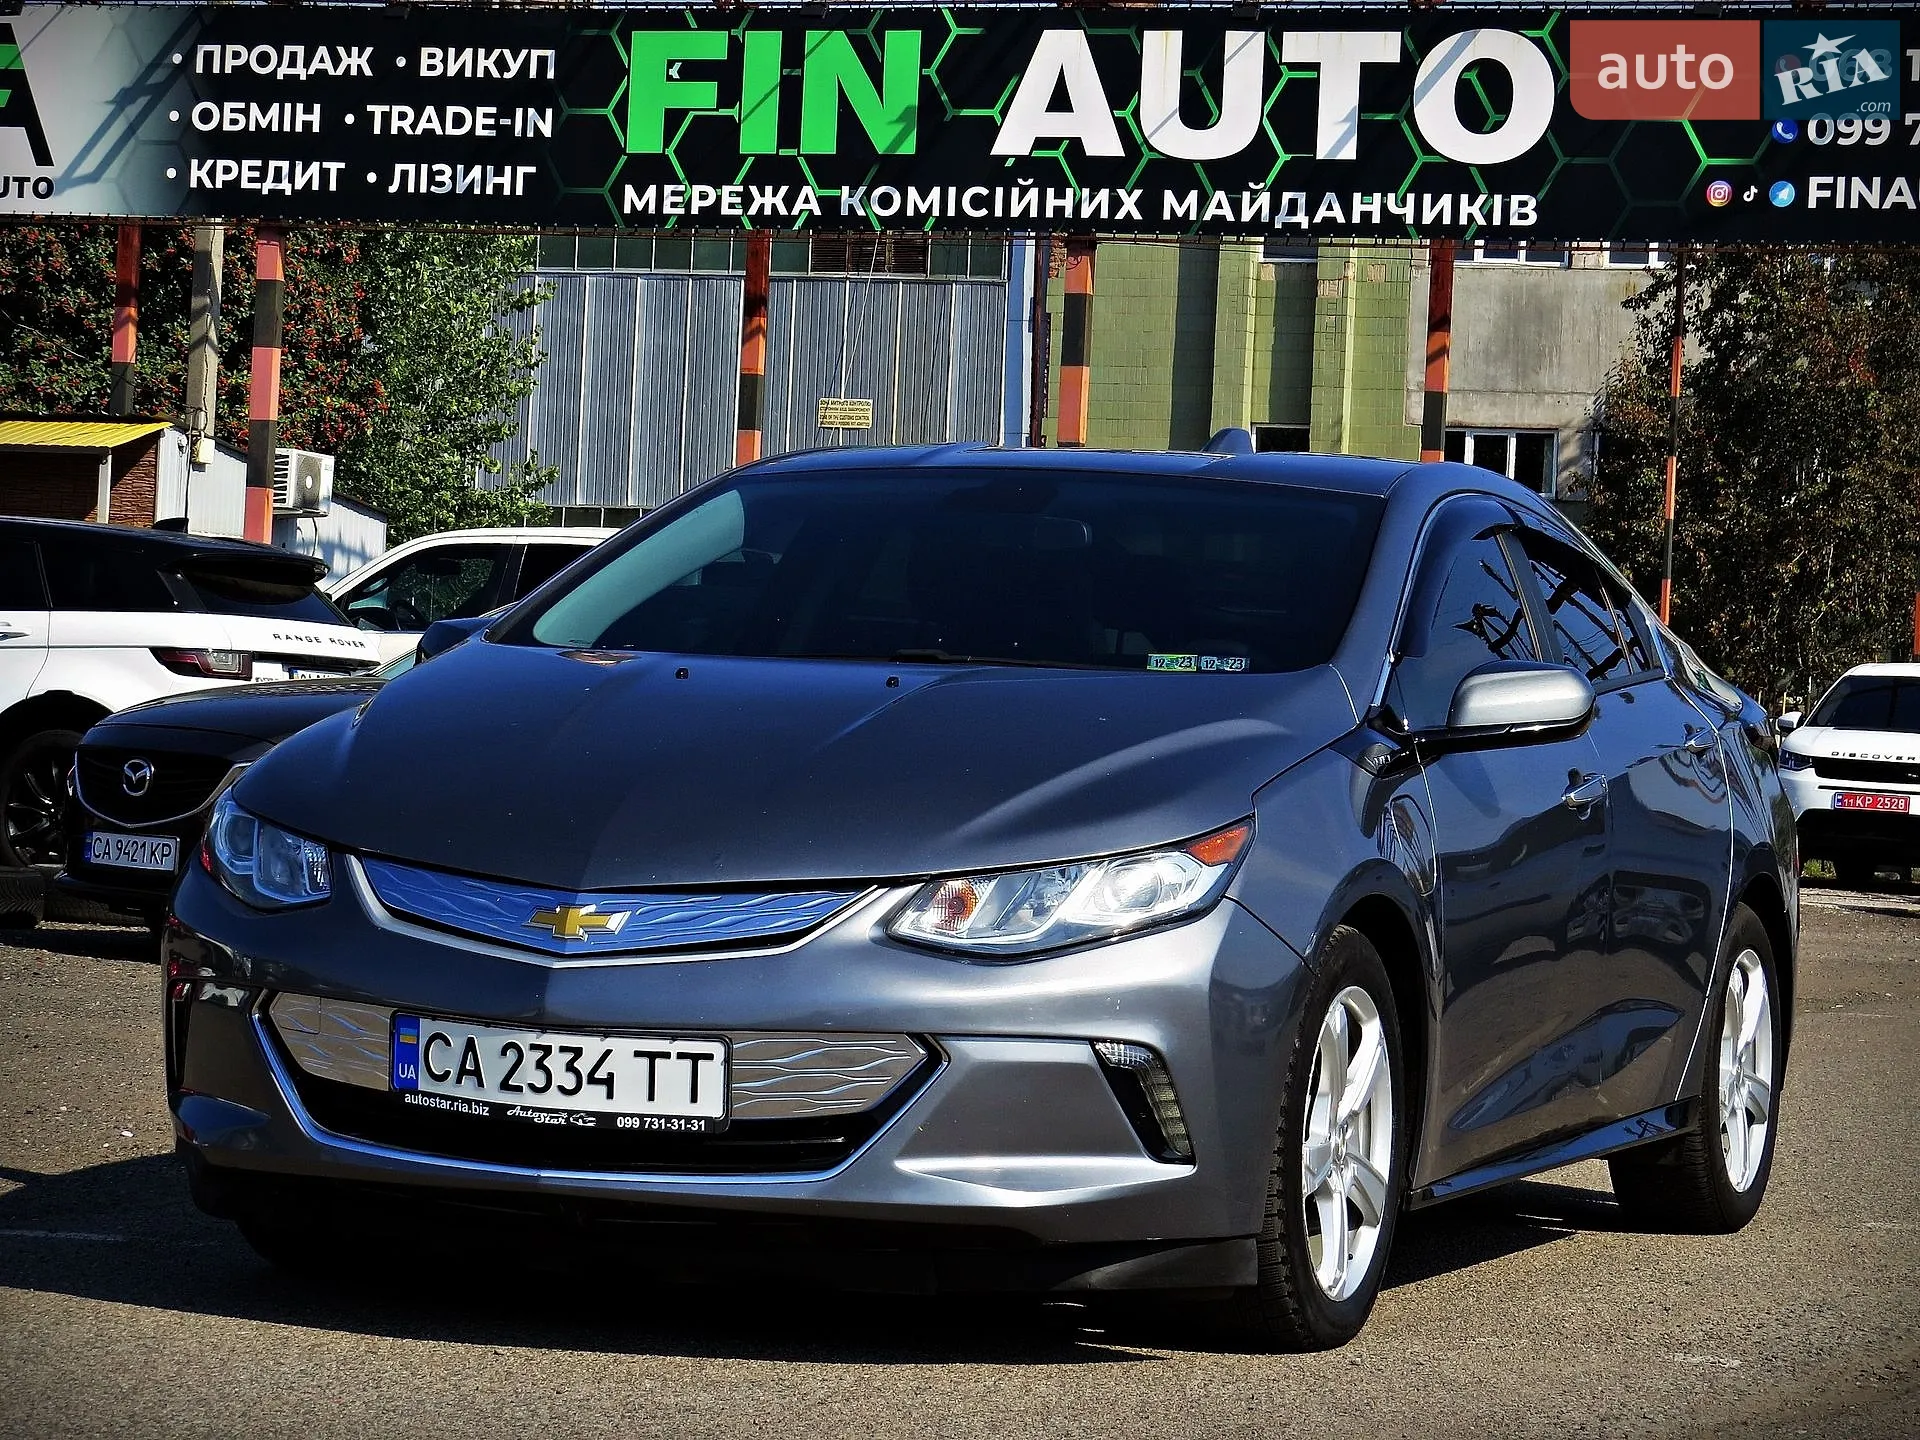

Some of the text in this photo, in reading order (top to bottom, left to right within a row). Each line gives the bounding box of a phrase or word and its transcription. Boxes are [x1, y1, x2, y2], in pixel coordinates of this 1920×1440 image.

[195, 44, 556, 81] ПРОДАЖ ВИКУП
[626, 28, 1555, 165] FIN AUTO
[191, 102, 322, 133] ОБМІН
[367, 104, 554, 138] TRADE-IN
[1807, 112, 1891, 146] 099
[189, 159, 537, 196] КРЕДИТ ЛІЗИНГ
[1807, 176, 1920, 210] FINA
[623, 178, 1538, 230] МЕРЕЖА КОМІСІЙНИХ МАЙДАНЧИКІВ
[272, 633, 366, 648] RANGE ROVER
[1831, 752, 1920, 760] DISCOVER
[1876, 798, 1905, 810] 2528
[92, 837, 172, 866] CA 9421 KP
[399, 1062, 416, 1080] UA
[423, 1032, 714, 1104] CA 2334 TT
[404, 1093, 490, 1116] autostar.ria.biz
[617, 1116, 706, 1131] 099 731-31-31
